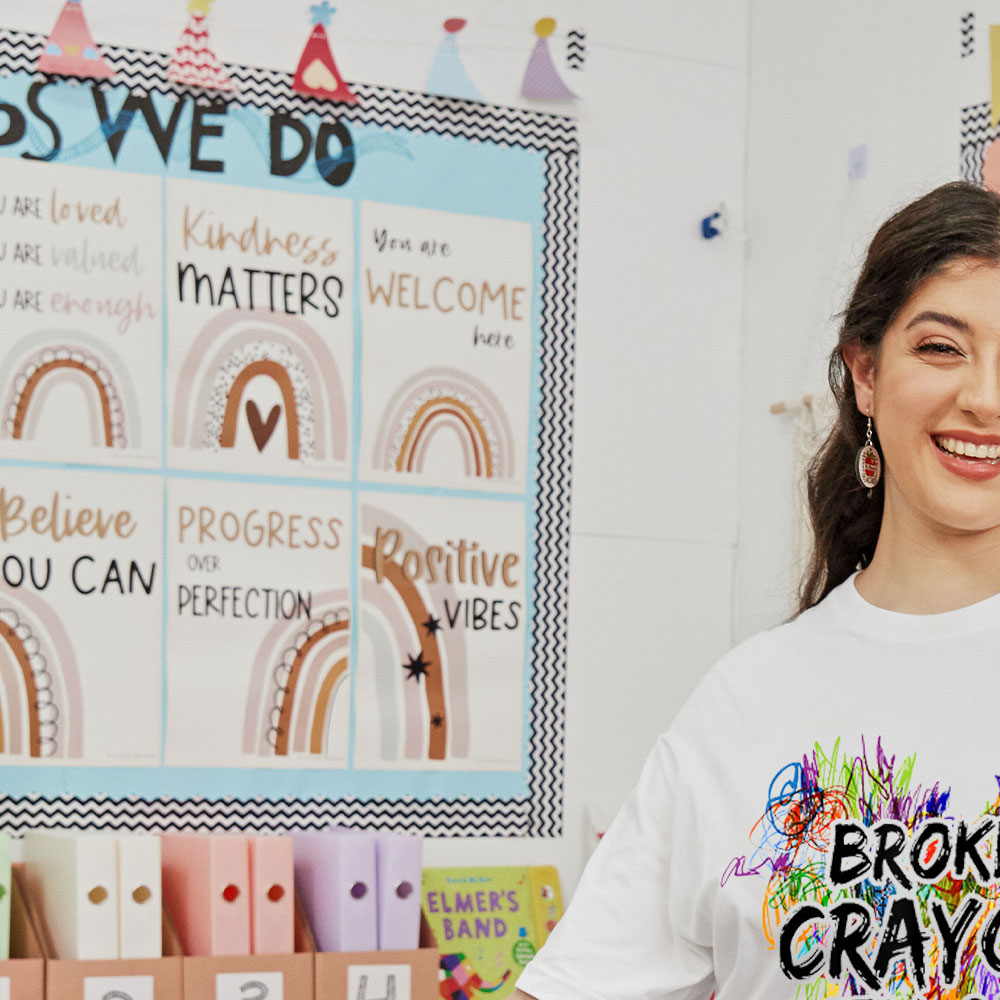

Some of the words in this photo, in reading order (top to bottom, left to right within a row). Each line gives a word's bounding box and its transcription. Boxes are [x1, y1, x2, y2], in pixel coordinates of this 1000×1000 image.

[90, 80, 227, 173] WE
[270, 108, 356, 187] DO
[13, 193, 43, 220] ARE
[51, 188, 127, 229] loved
[182, 205, 339, 266] Kindness
[373, 228, 410, 254] You
[419, 238, 452, 258] are
[13, 242, 43, 267] ARE
[51, 237, 143, 276] valued
[13, 290, 43, 314] ARE
[50, 291, 157, 335] enough
[366, 268, 526, 322] WELCOME
[473, 326, 516, 350] here
[0, 487, 137, 542] Believe
[178, 506, 342, 550] PROGRESS
[72, 555, 156, 595] CAN
[188, 554, 221, 572] OVER
[374, 526, 521, 588] Positive
[178, 583, 313, 620] PERFECTION
[444, 597, 522, 631] VIBES
[427, 889, 519, 914] ELMER'S
[443, 917, 507, 941] BAND
